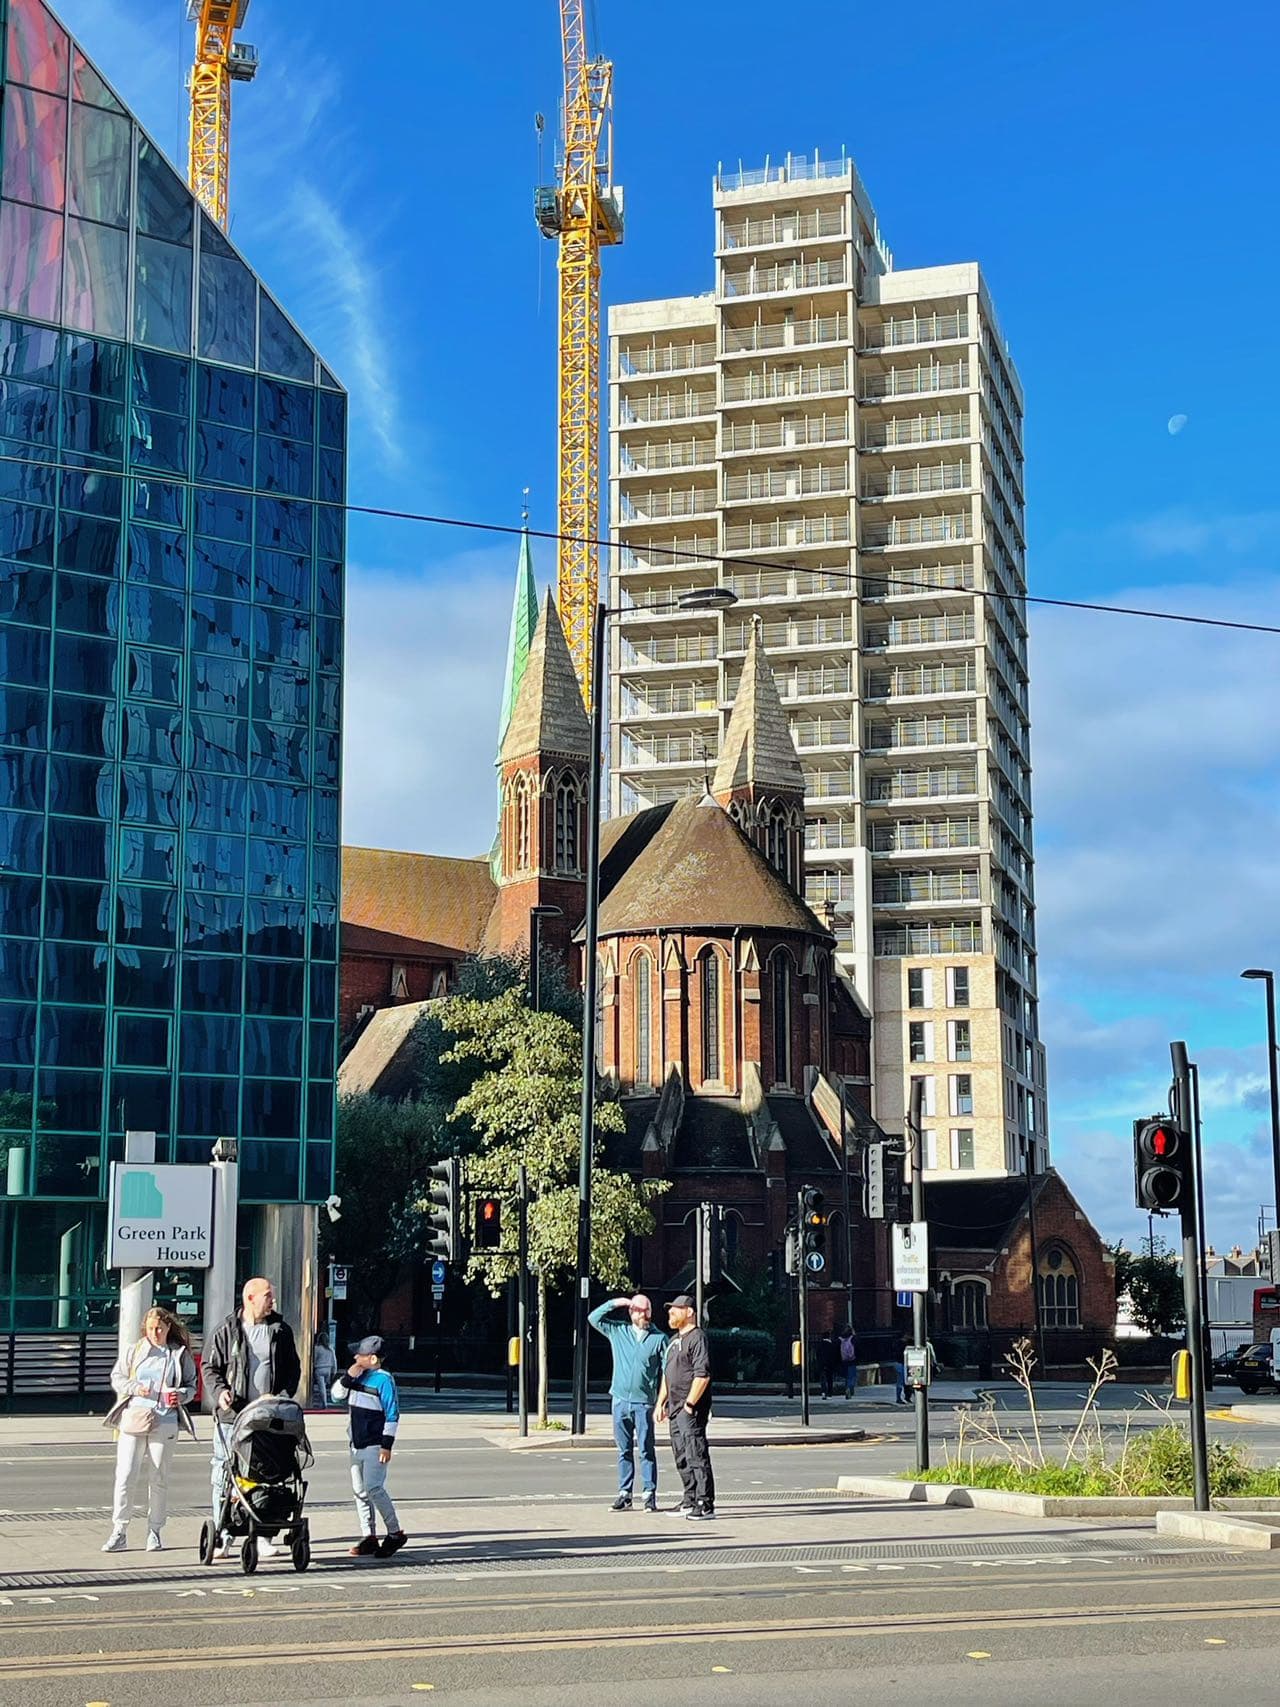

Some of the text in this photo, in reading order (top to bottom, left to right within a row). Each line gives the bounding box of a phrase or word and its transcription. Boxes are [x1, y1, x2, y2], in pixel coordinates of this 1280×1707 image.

[118, 1226, 206, 1241] Green Park
[157, 1247, 206, 1261] House
[168, 1584, 346, 1597] LOOK
